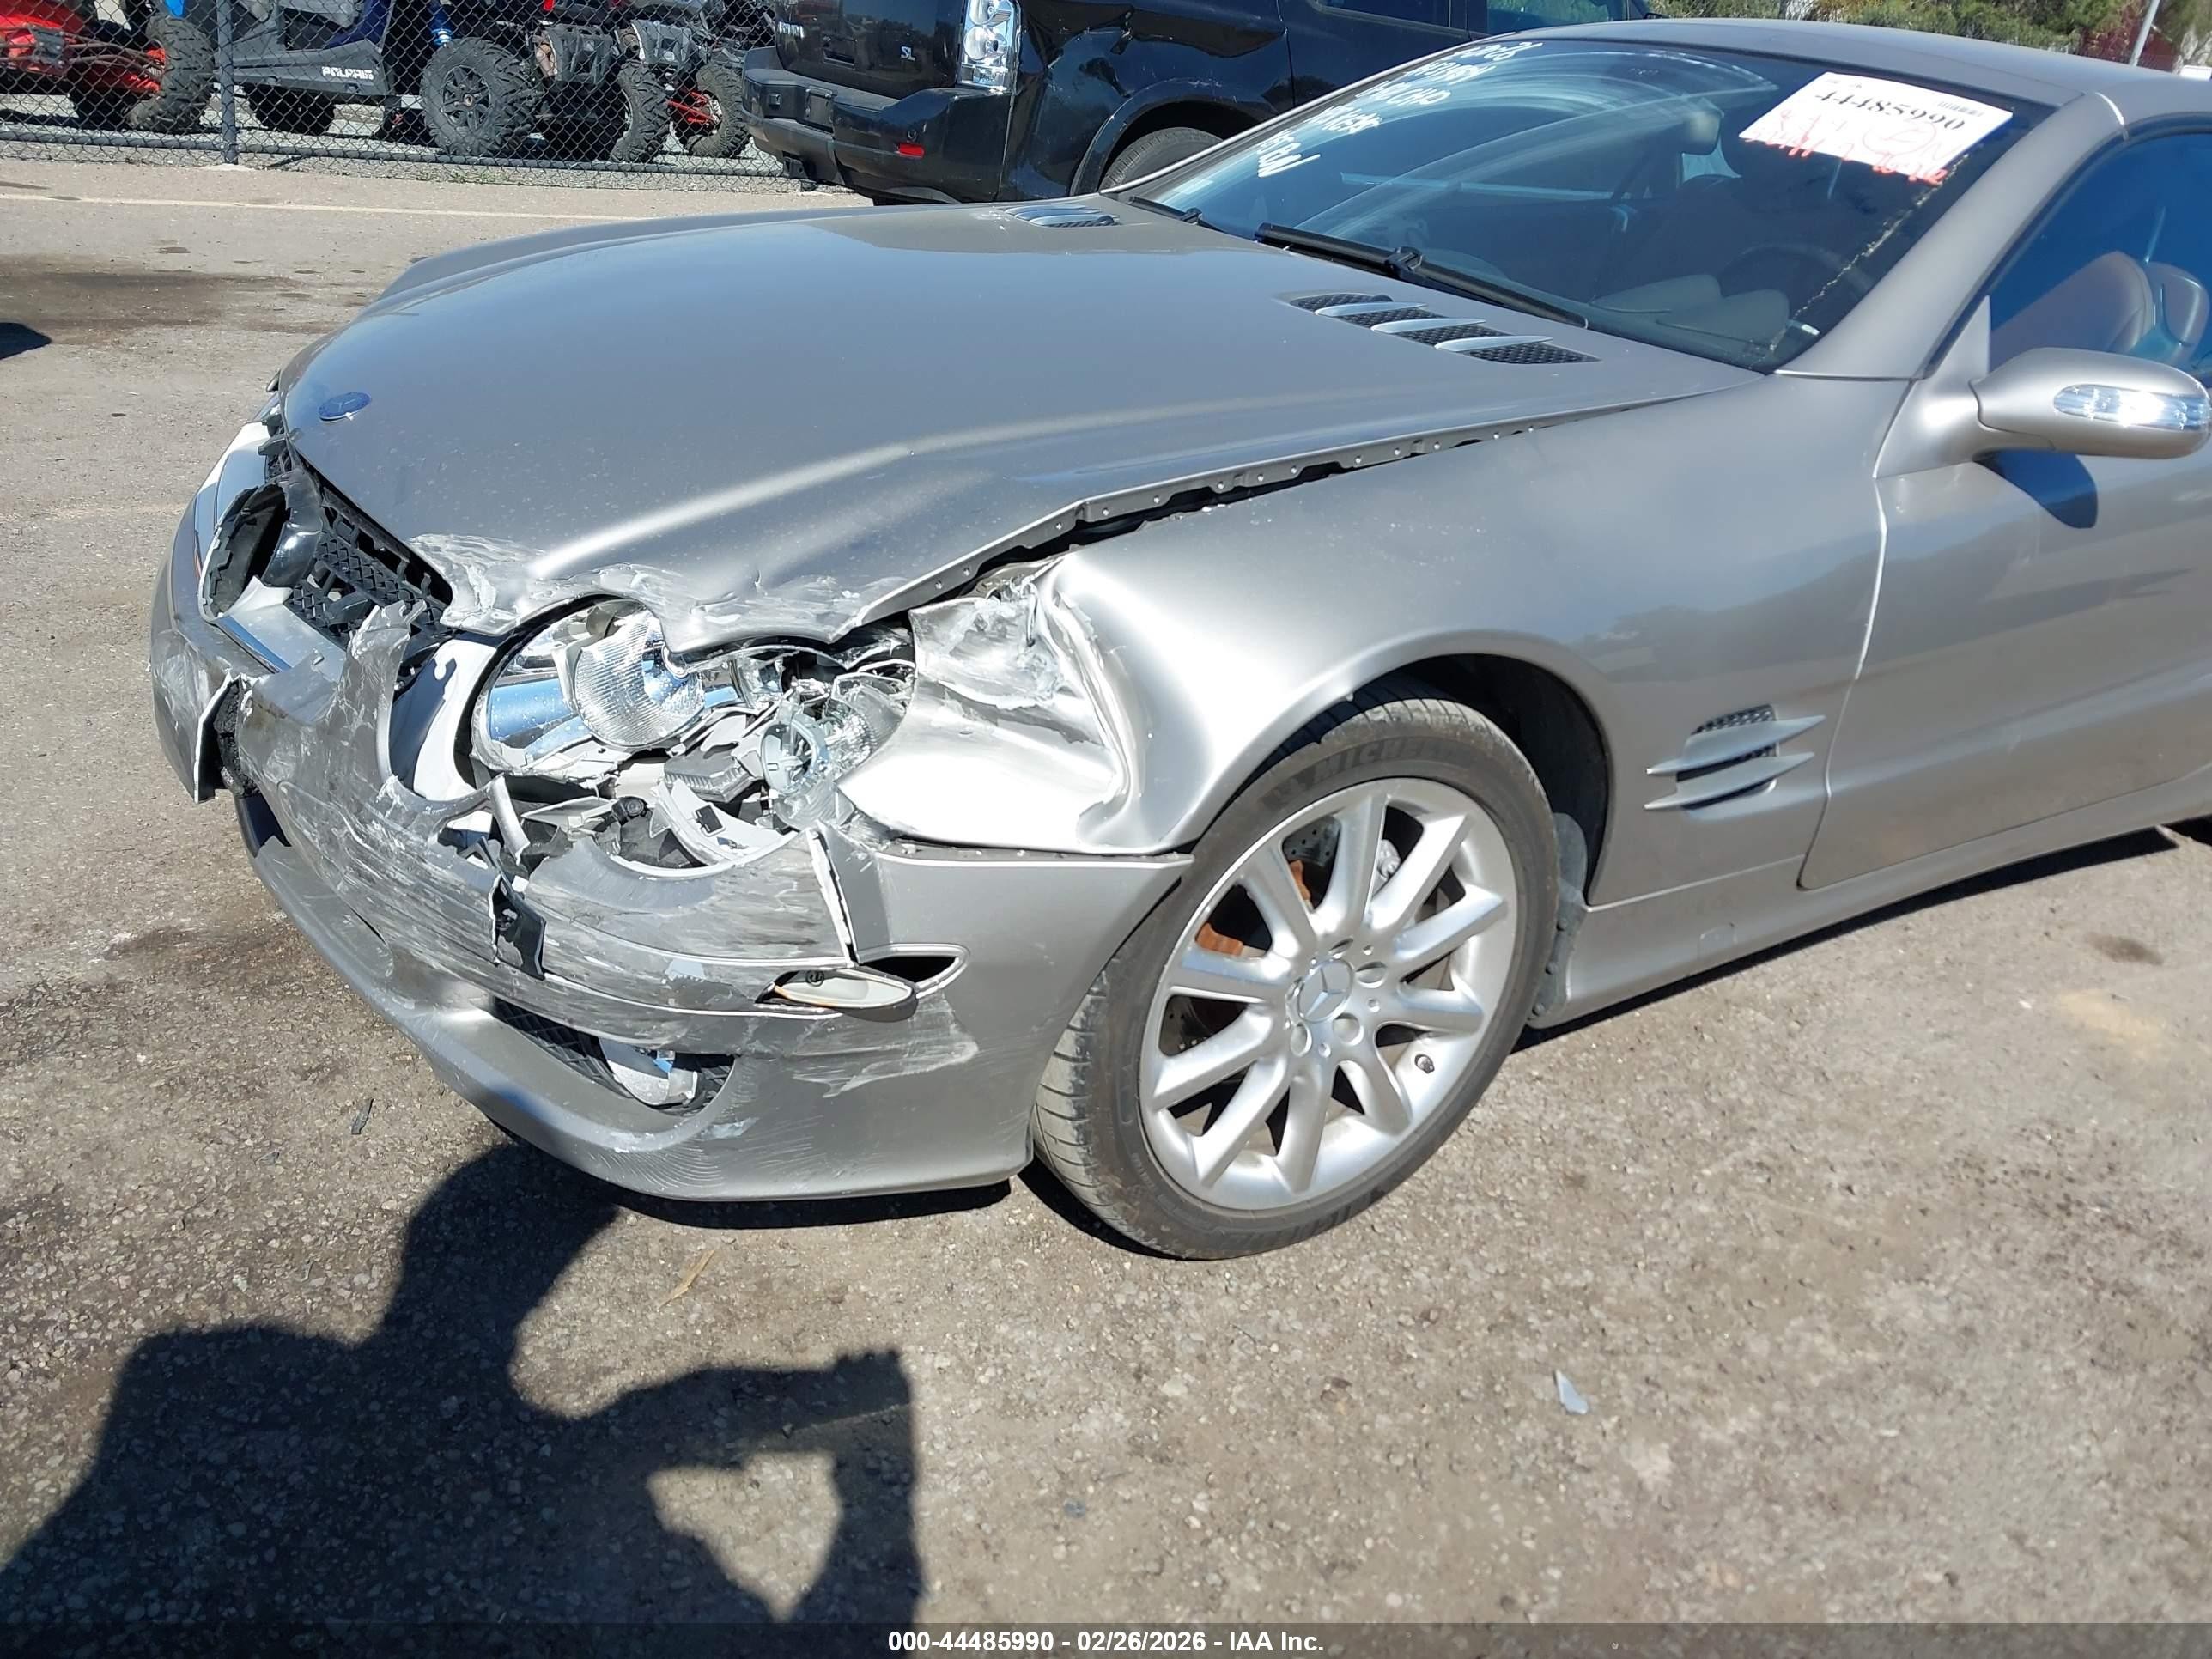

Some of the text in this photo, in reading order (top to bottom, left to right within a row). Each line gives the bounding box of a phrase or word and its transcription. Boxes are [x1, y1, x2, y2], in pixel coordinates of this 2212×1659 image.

[901, 46, 916, 62] SL
[321, 66, 374, 81] POLARIS
[1814, 91, 1966, 131] 44485990
[1314, 736, 1465, 787] MICHE
